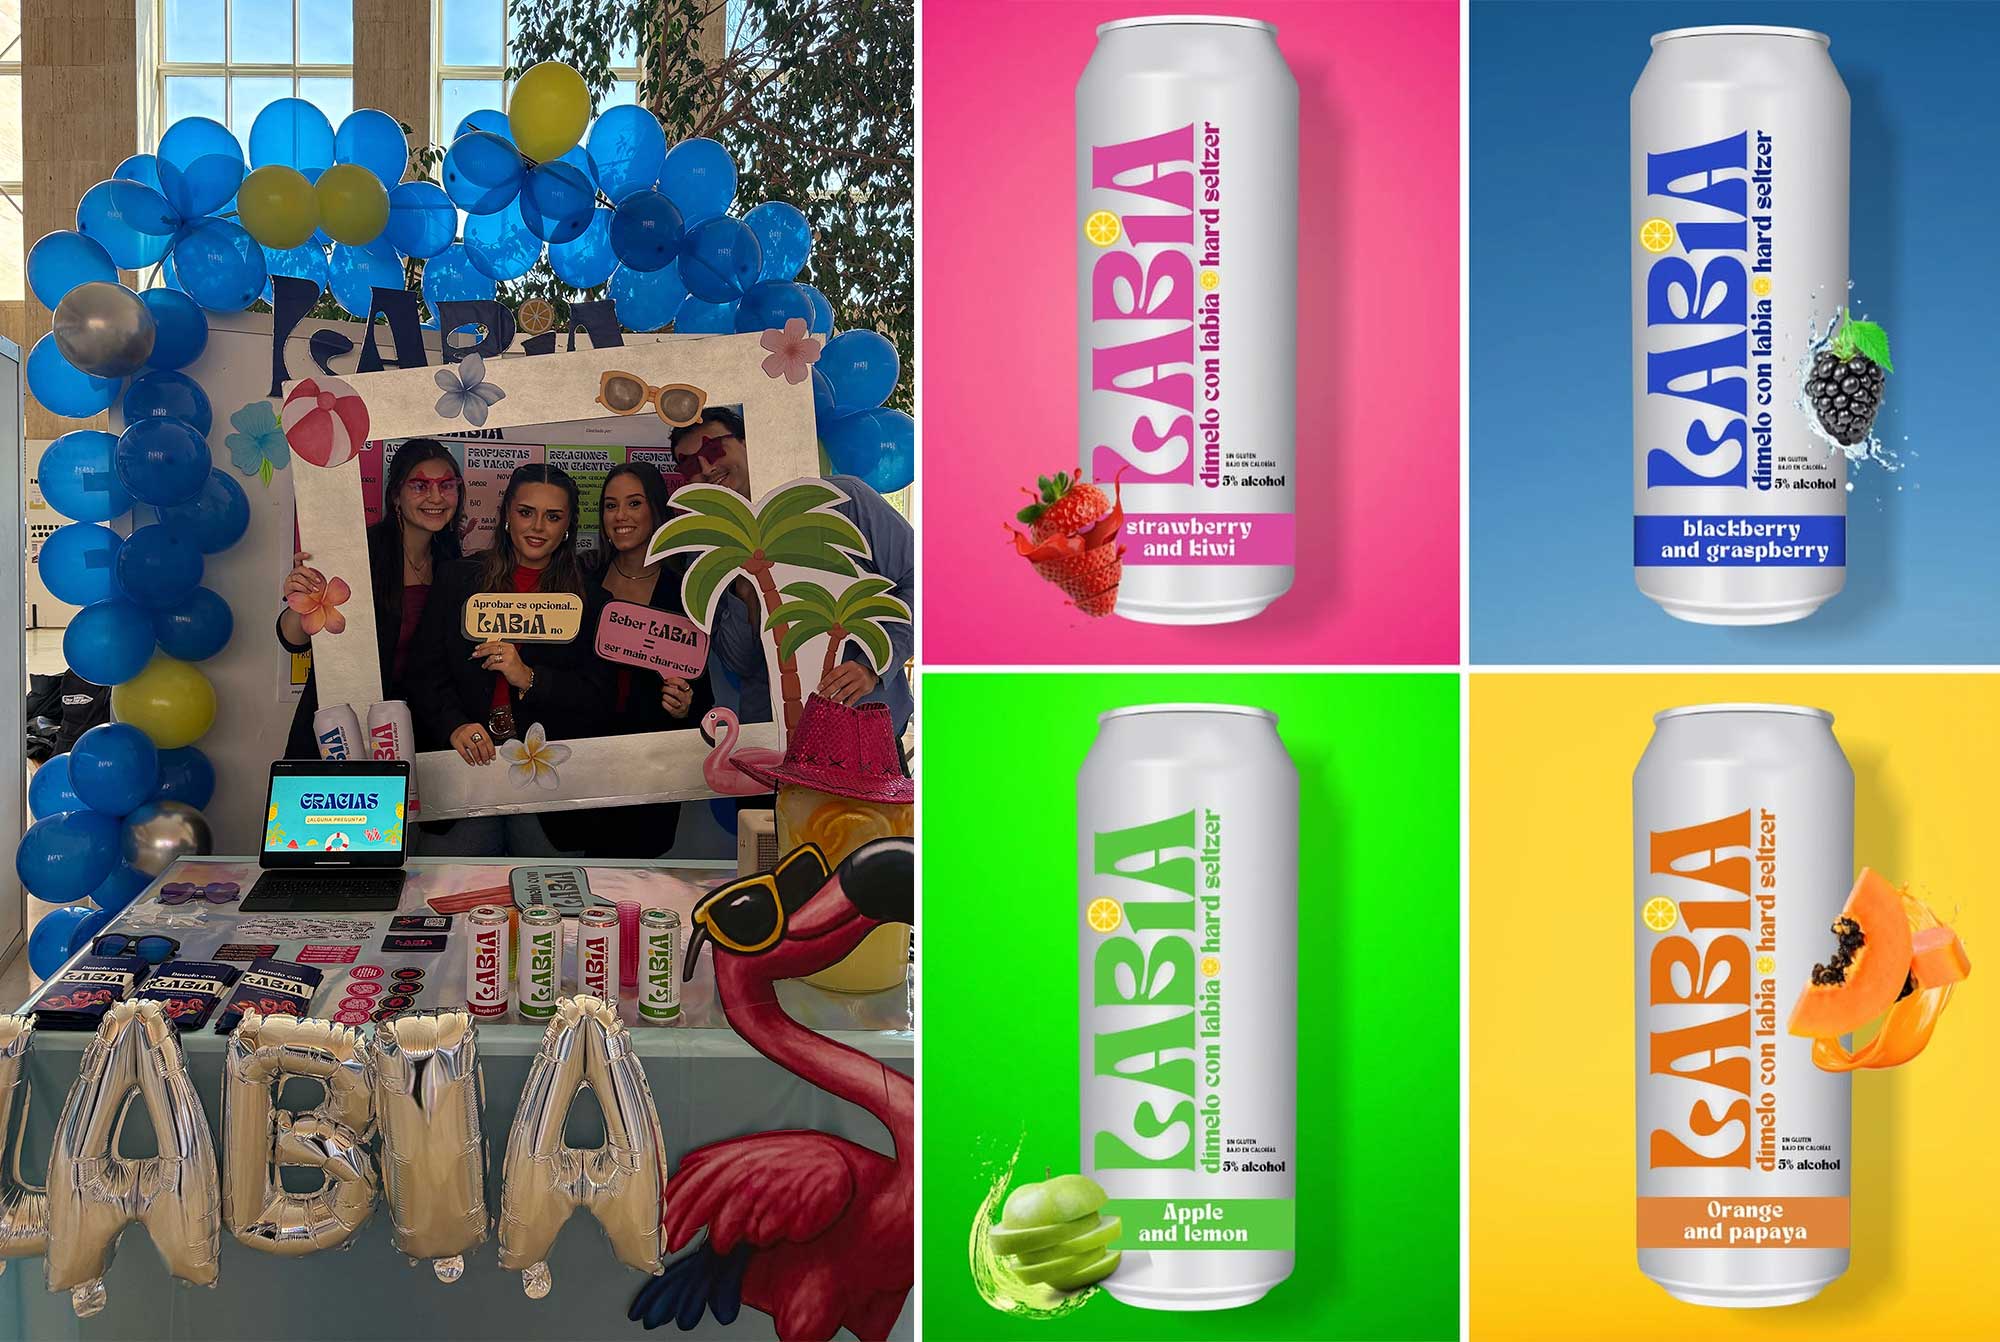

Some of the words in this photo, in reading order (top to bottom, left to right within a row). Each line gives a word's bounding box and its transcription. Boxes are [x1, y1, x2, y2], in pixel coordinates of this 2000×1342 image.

[1200, 122, 1220, 202] seltzer
[1752, 130, 1772, 209] seltzer
[1200, 209, 1220, 266] hard
[1752, 216, 1772, 272] hard
[1199, 294, 1220, 351] labia
[1751, 300, 1772, 356] labia
[1205, 359, 1220, 400] con
[1757, 363, 1772, 405] con
[468, 448, 530, 459] PROPUESTAS
[468, 460, 481, 468] DE
[483, 460, 515, 469] VALOR
[549, 450, 608, 460] RELACIONES
[1222, 475, 1238, 486] 5%
[1242, 475, 1285, 486] alcohol
[1775, 478, 1790, 489] 5%
[1793, 478, 1836, 489] alcohol
[1126, 518, 1252, 539] strawberry
[1683, 520, 1800, 540] blackberry
[1144, 539, 1182, 556] and
[1189, 539, 1236, 556] kiwi
[1661, 541, 1700, 558] and
[1707, 543, 1829, 562] graspberry
[473, 600, 514, 610] Aprobar
[530, 600, 578, 612] opcional...
[610, 612, 646, 630] Beber
[604, 642, 621, 653] ser
[622, 650, 648, 661] main
[650, 655, 700, 675] character
[301, 793, 379, 810] GRACIAS
[1200, 808, 1220, 888] seltzer
[1756, 808, 1776, 888] seltzer
[1200, 896, 1220, 952] hard
[1756, 894, 1776, 952] hard
[1200, 980, 1220, 1038] labia
[1756, 979, 1776, 1036] labia
[1206, 1044, 1220, 1088] con
[1762, 1043, 1776, 1086] con
[1223, 1161, 1238, 1172] 5%
[1241, 1161, 1285, 1172] alcohol
[1778, 1159, 1794, 1170] 5%
[1797, 1159, 1840, 1170] alcohol
[1164, 1202, 1224, 1224] Apple
[1708, 1200, 1784, 1222] Orange
[1138, 1224, 1178, 1242] and
[1184, 1224, 1248, 1242] lemon
[1684, 1222, 1722, 1240] and
[1729, 1226, 1807, 1244] papaya
